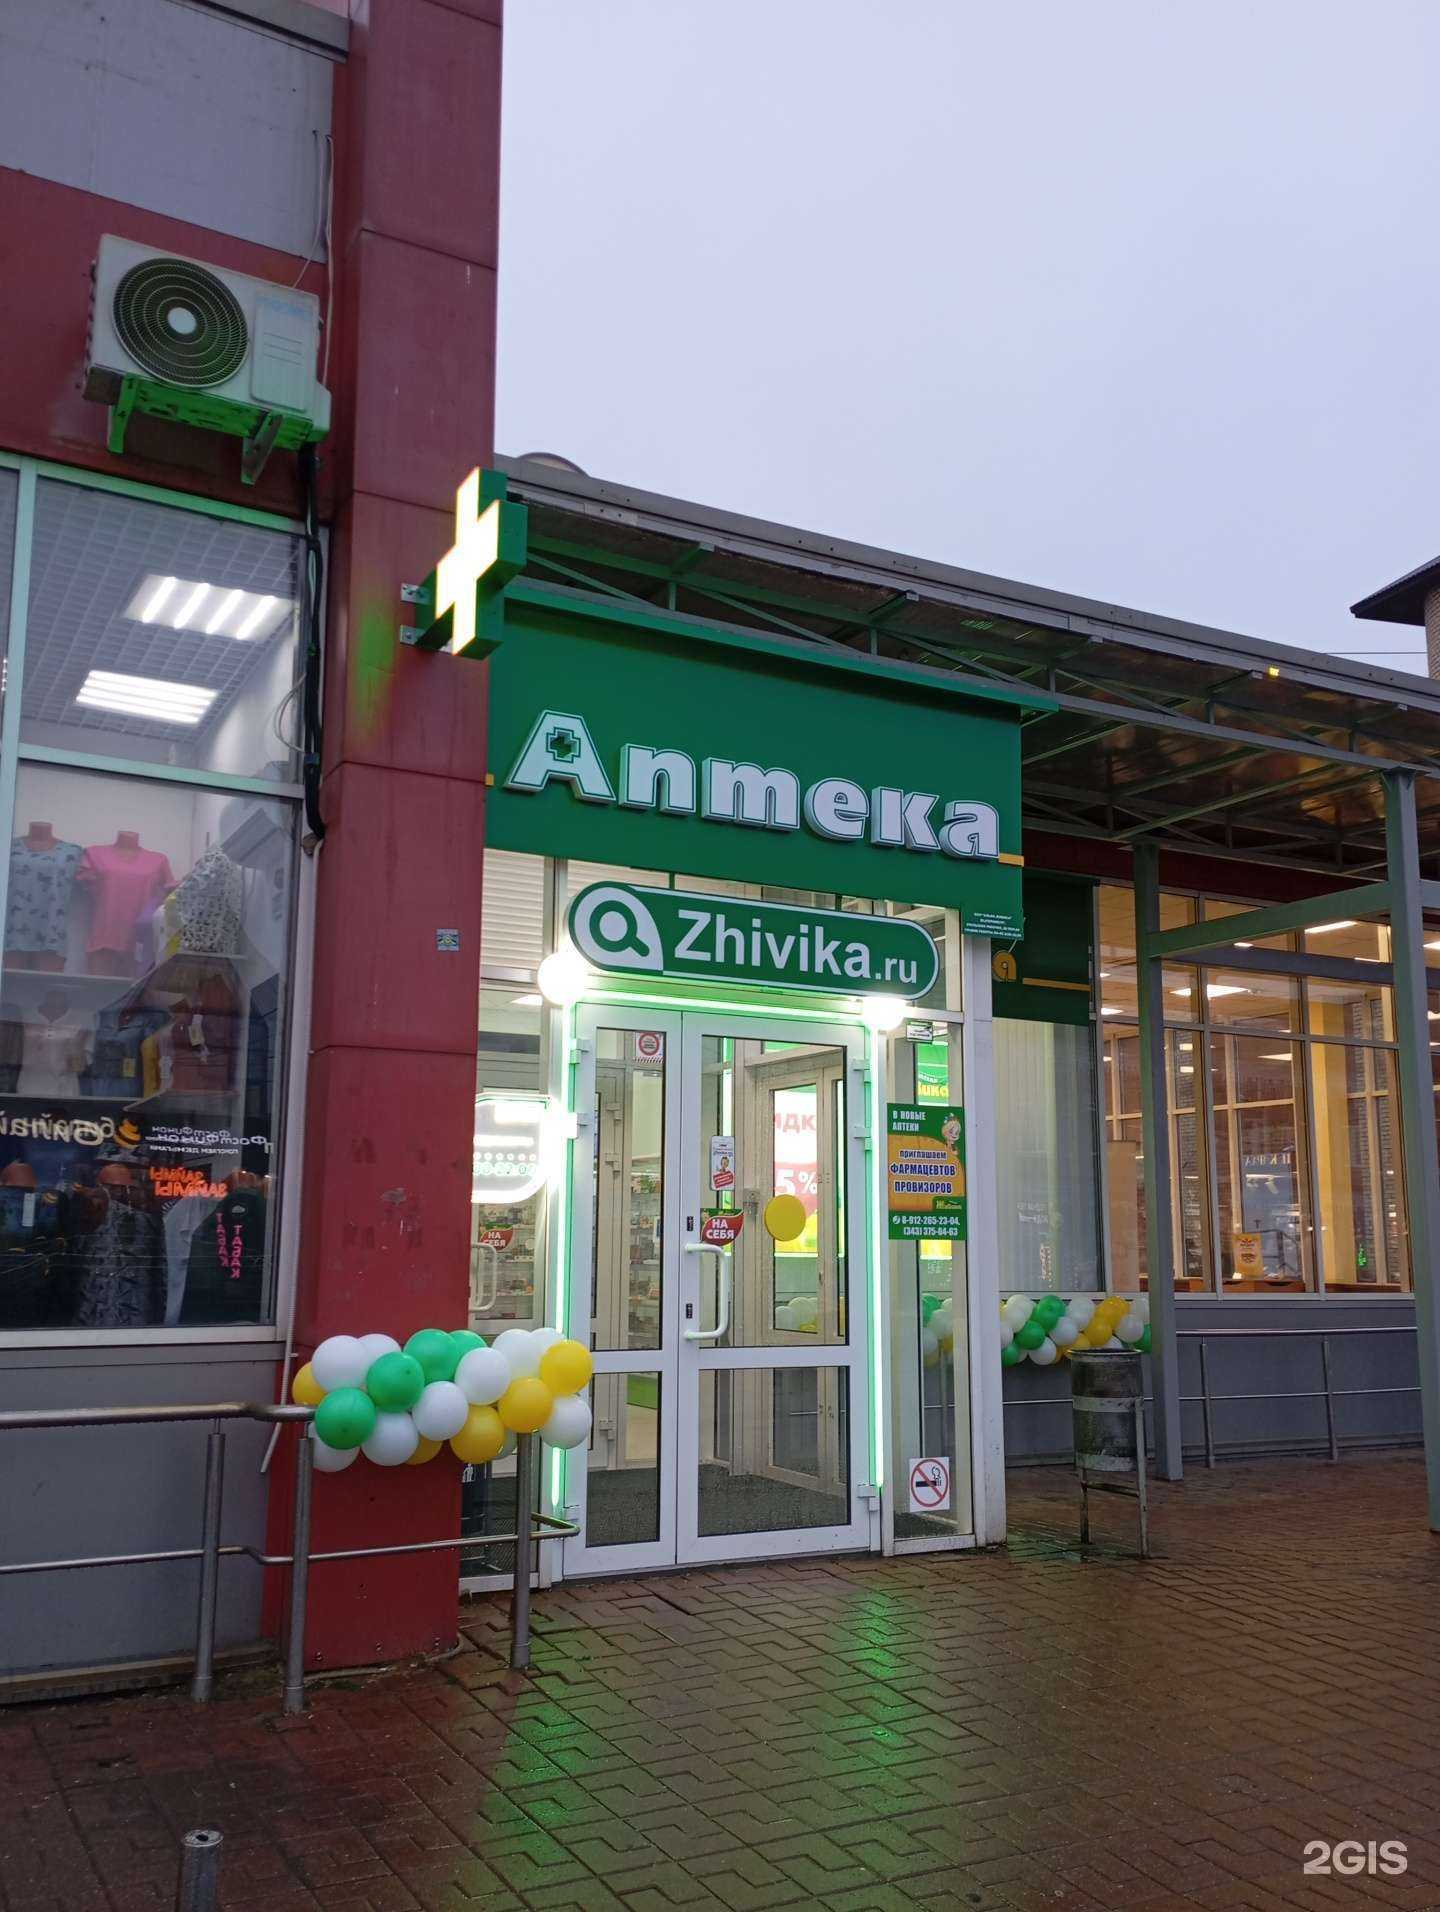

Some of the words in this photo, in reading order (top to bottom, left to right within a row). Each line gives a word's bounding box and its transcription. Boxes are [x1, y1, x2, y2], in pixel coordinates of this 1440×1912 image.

[504, 709, 1000, 859] Аптека
[674, 909, 917, 984] Zhivika.ru
[892, 1110, 898, 1120] В
[900, 1111, 926, 1121] НОВЫЕ
[892, 1122, 920, 1132] АПТЕКИ
[890, 1163, 956, 1177] ФАРМАЦЕВТОВ
[894, 1181, 953, 1194] ПРОВИЗОРОВ
[712, 1219, 728, 1229] НА
[488, 1231, 501, 1239] НА
[706, 1229, 735, 1240] СЕБЯ
